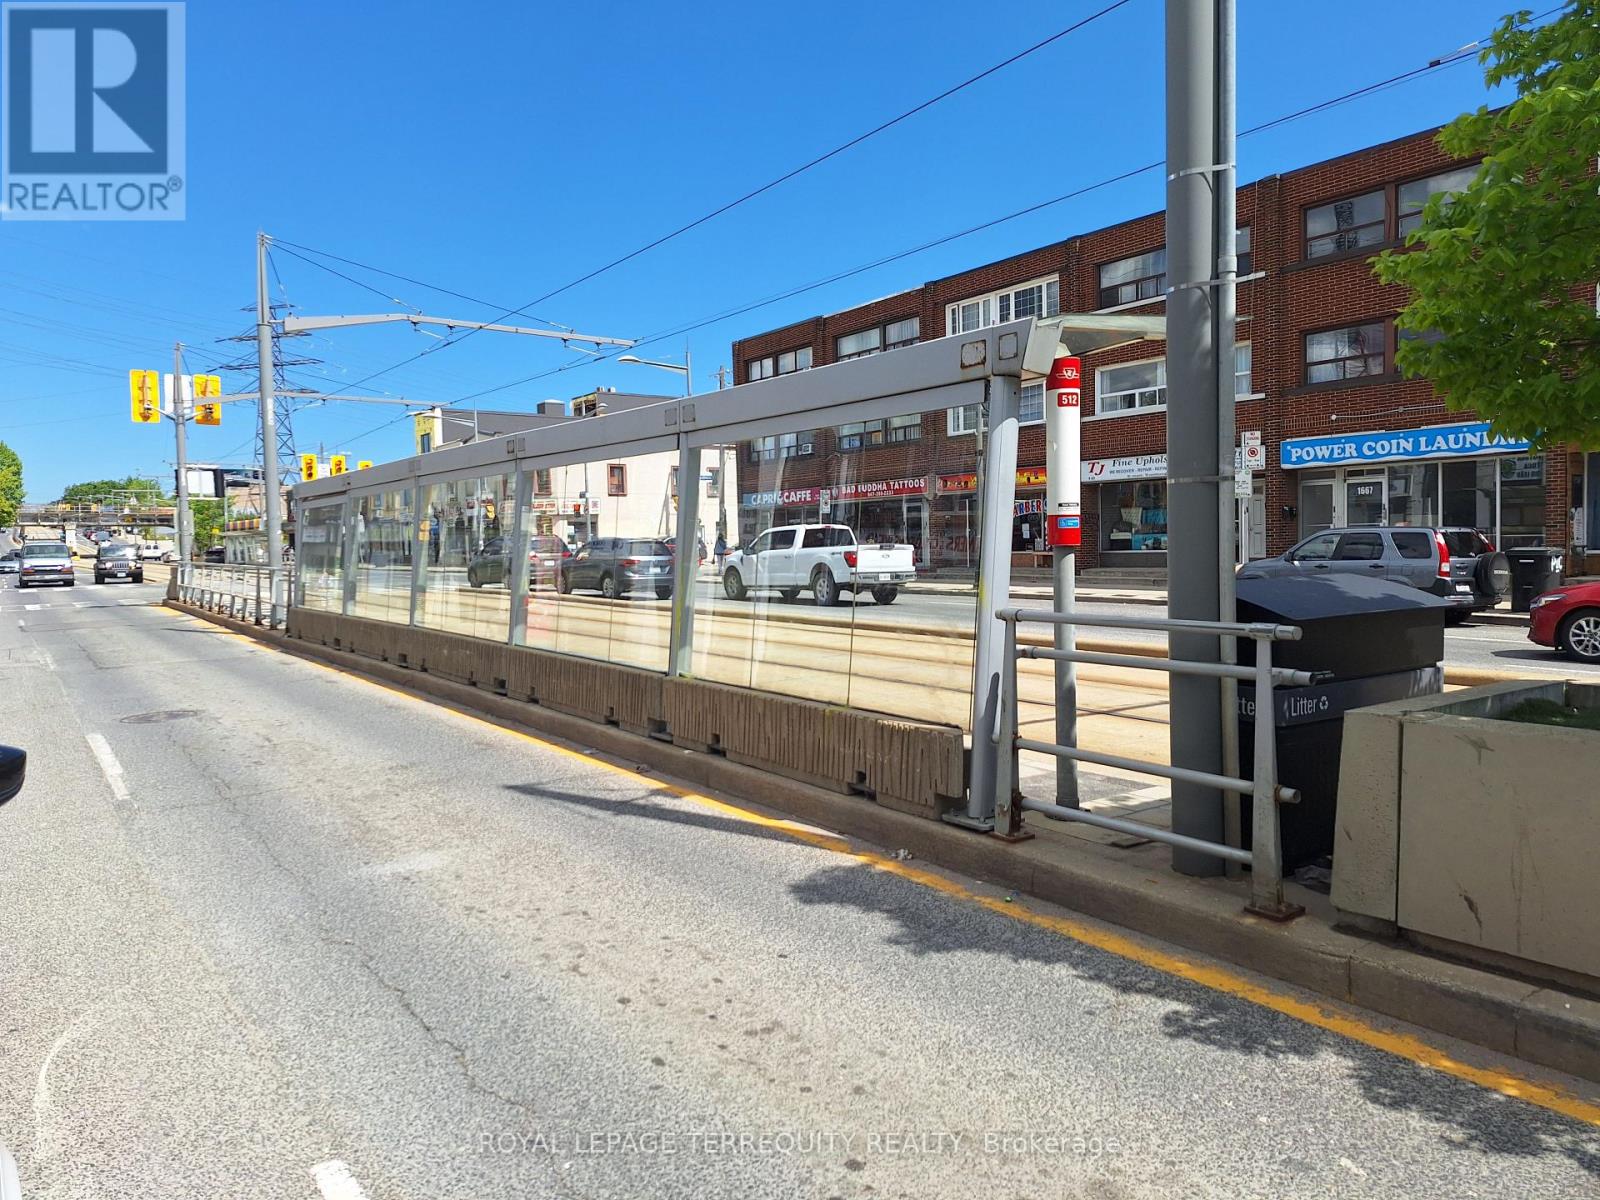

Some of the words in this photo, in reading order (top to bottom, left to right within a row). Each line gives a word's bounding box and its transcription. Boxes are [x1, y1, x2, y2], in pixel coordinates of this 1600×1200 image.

[1062, 394, 1077, 405] 512
[1291, 443, 1358, 462] POWER
[1362, 438, 1414, 456] COIN
[1112, 458, 1133, 467] Fine
[1135, 455, 1168, 466] Uphols
[889, 478, 925, 490] TATTOOS
[783, 489, 812, 503] CAFFE
[1291, 697, 1318, 717] Litter
